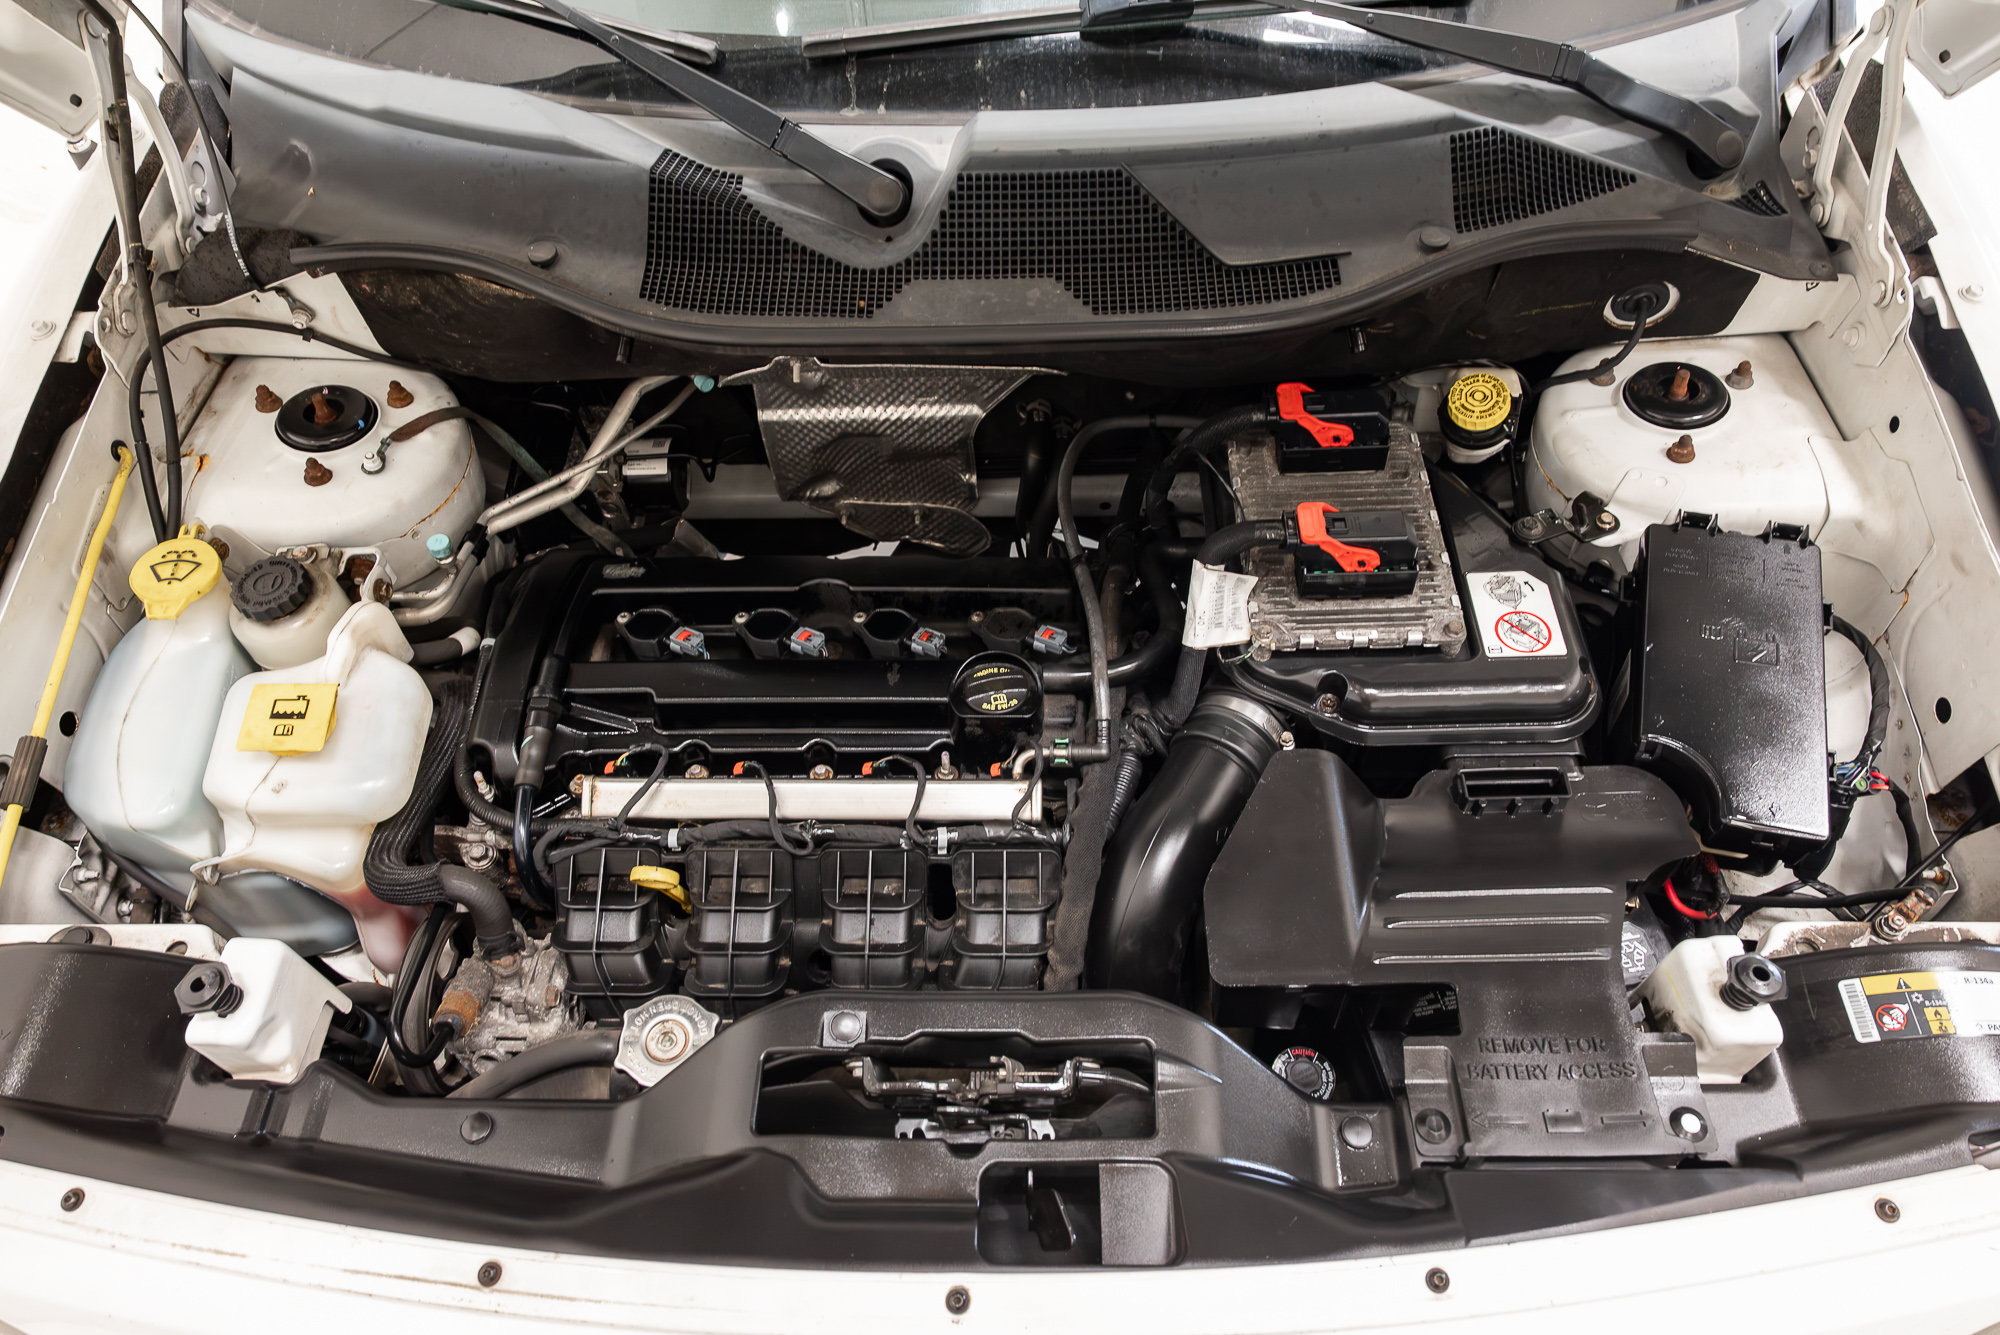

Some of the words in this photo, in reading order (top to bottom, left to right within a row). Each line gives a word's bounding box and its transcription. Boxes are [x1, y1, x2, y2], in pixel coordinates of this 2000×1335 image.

[1987, 1023, 2000, 1031] PA
[1478, 1037, 1561, 1054] REMOVE
[1564, 1036, 1608, 1053] FOR
[1291, 1048, 1316, 1058] CAUTION
[1467, 1062, 1548, 1080] BATTERY
[1557, 1061, 1636, 1080] ACCESS
